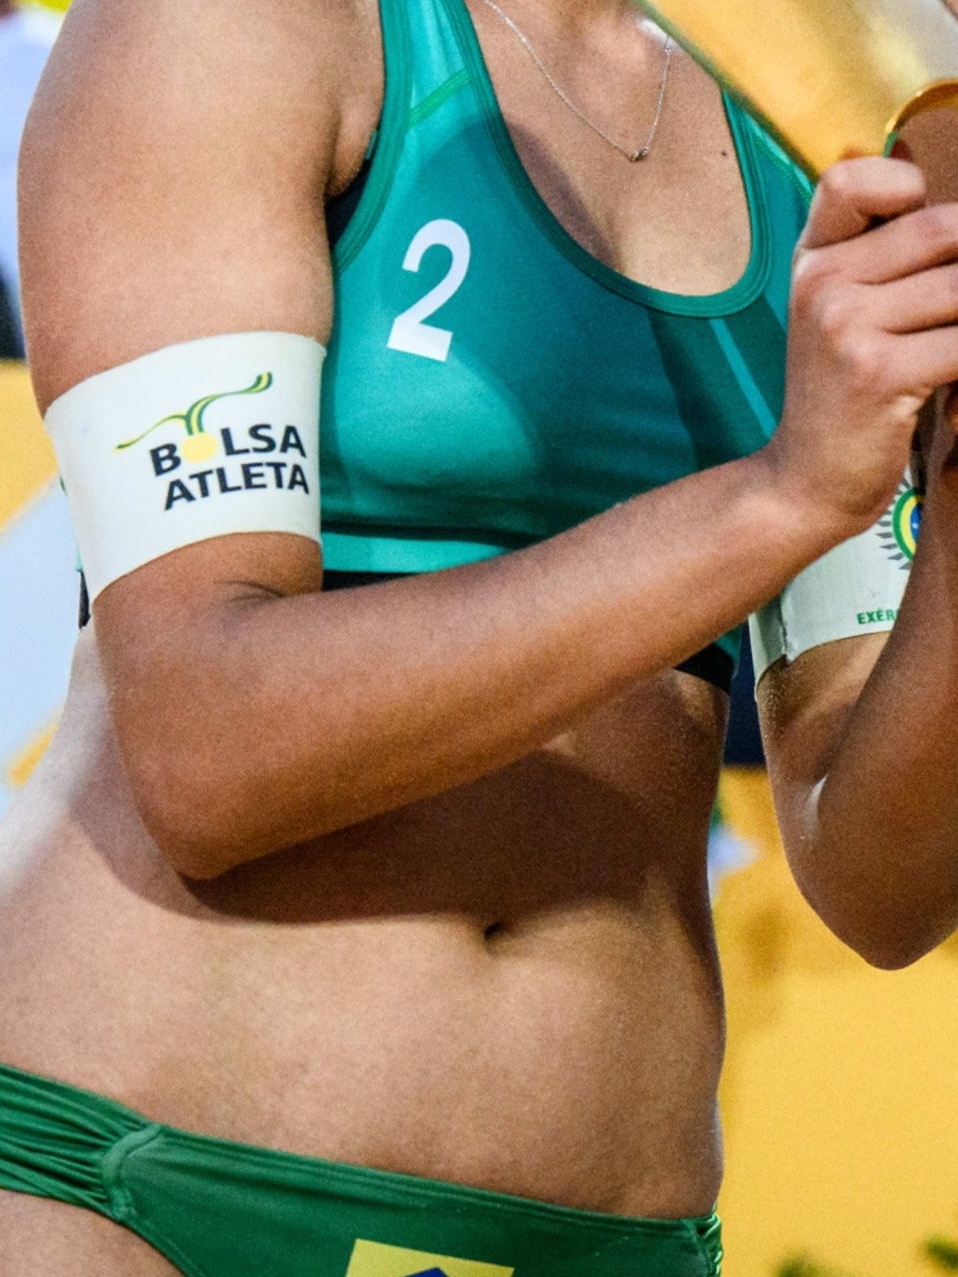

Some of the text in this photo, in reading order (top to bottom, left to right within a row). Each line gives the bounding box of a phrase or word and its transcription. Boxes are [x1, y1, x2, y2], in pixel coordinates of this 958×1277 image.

[387, 218, 471, 362] 2
[150, 424, 307, 477] BOLSA
[164, 462, 310, 512] ATLETA
[856, 607, 899, 625] EXÉR
